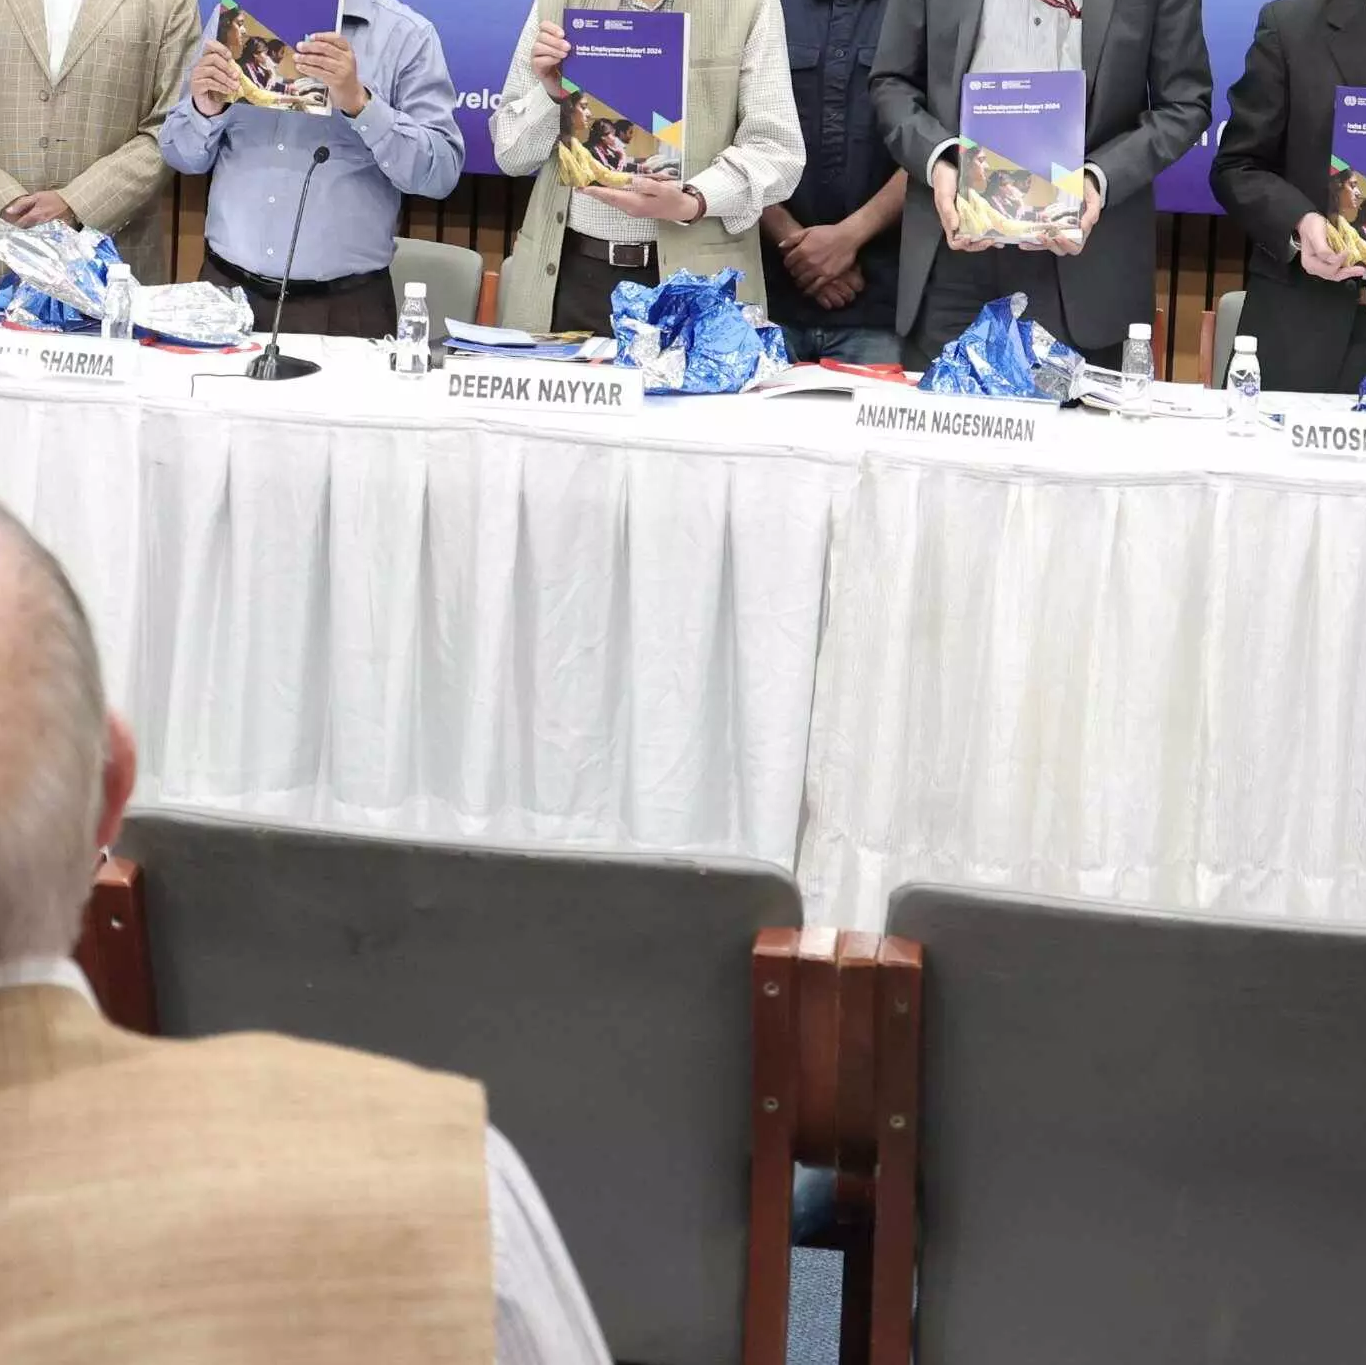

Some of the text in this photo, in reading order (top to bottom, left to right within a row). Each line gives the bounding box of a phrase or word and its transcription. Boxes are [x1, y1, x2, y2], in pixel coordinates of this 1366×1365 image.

[39, 349, 114, 377] SHARMA
[448, 373, 623, 407] DEEPAK NAYYAR
[855, 403, 1035, 442] ANANTHA NAGESWARAN
